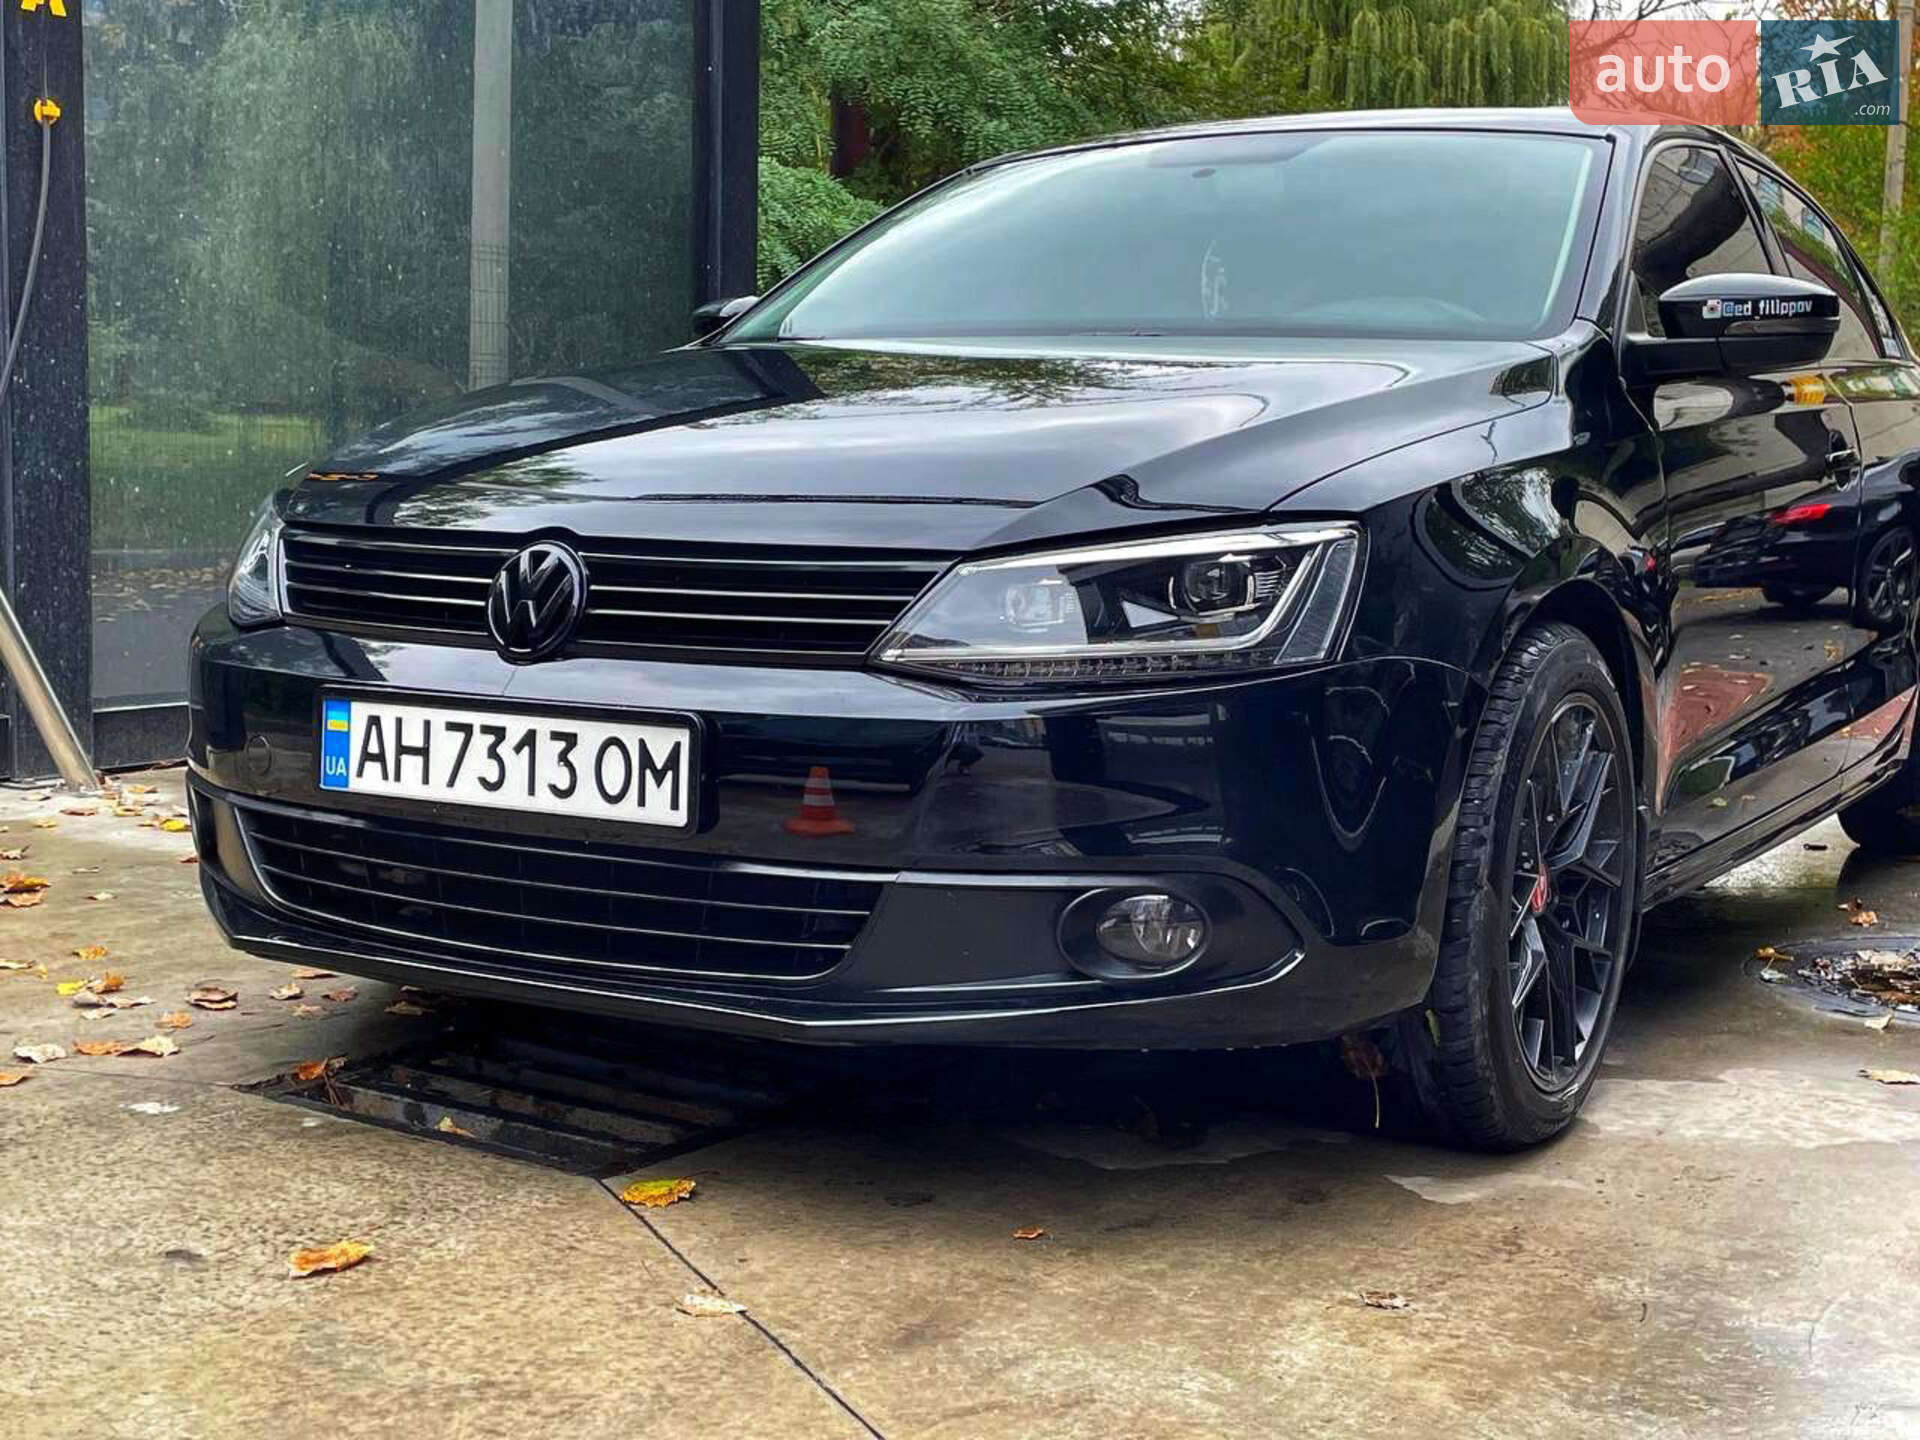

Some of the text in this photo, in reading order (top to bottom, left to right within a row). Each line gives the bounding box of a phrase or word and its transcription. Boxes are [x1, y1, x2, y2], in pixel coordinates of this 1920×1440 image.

[325, 755, 347, 777] UA
[356, 714, 681, 811] AH 7313 OM
